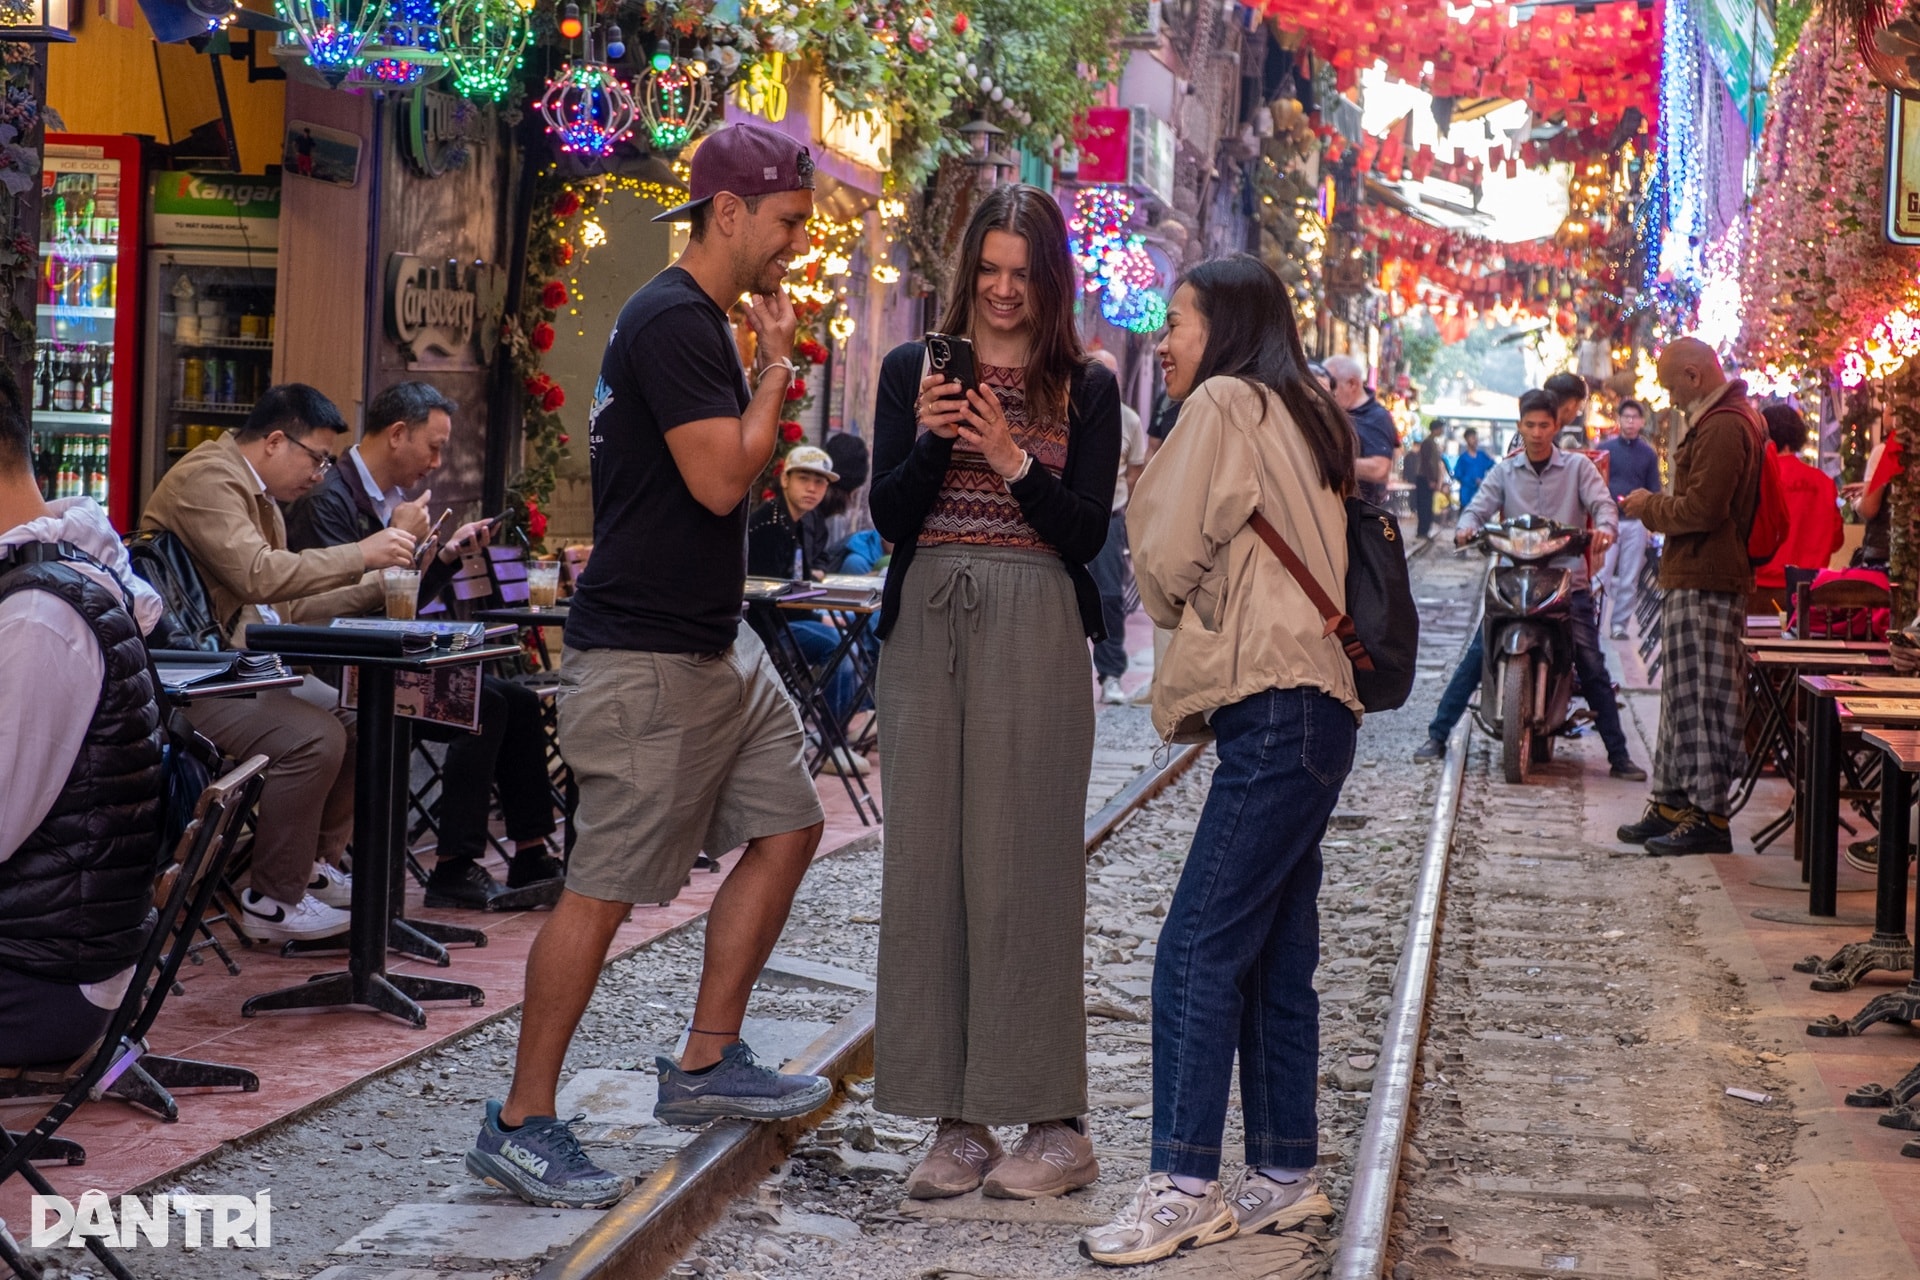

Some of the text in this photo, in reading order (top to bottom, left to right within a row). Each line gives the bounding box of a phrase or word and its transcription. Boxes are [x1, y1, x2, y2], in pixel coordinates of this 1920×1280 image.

[61, 161, 110, 170] ICE COLD
[1907, 192, 1920, 213] G
[395, 256, 475, 345] Carlsberg
[500, 1140, 550, 1179] HOKA
[1237, 1191, 1264, 1212] N
[1151, 1205, 1181, 1227] N
